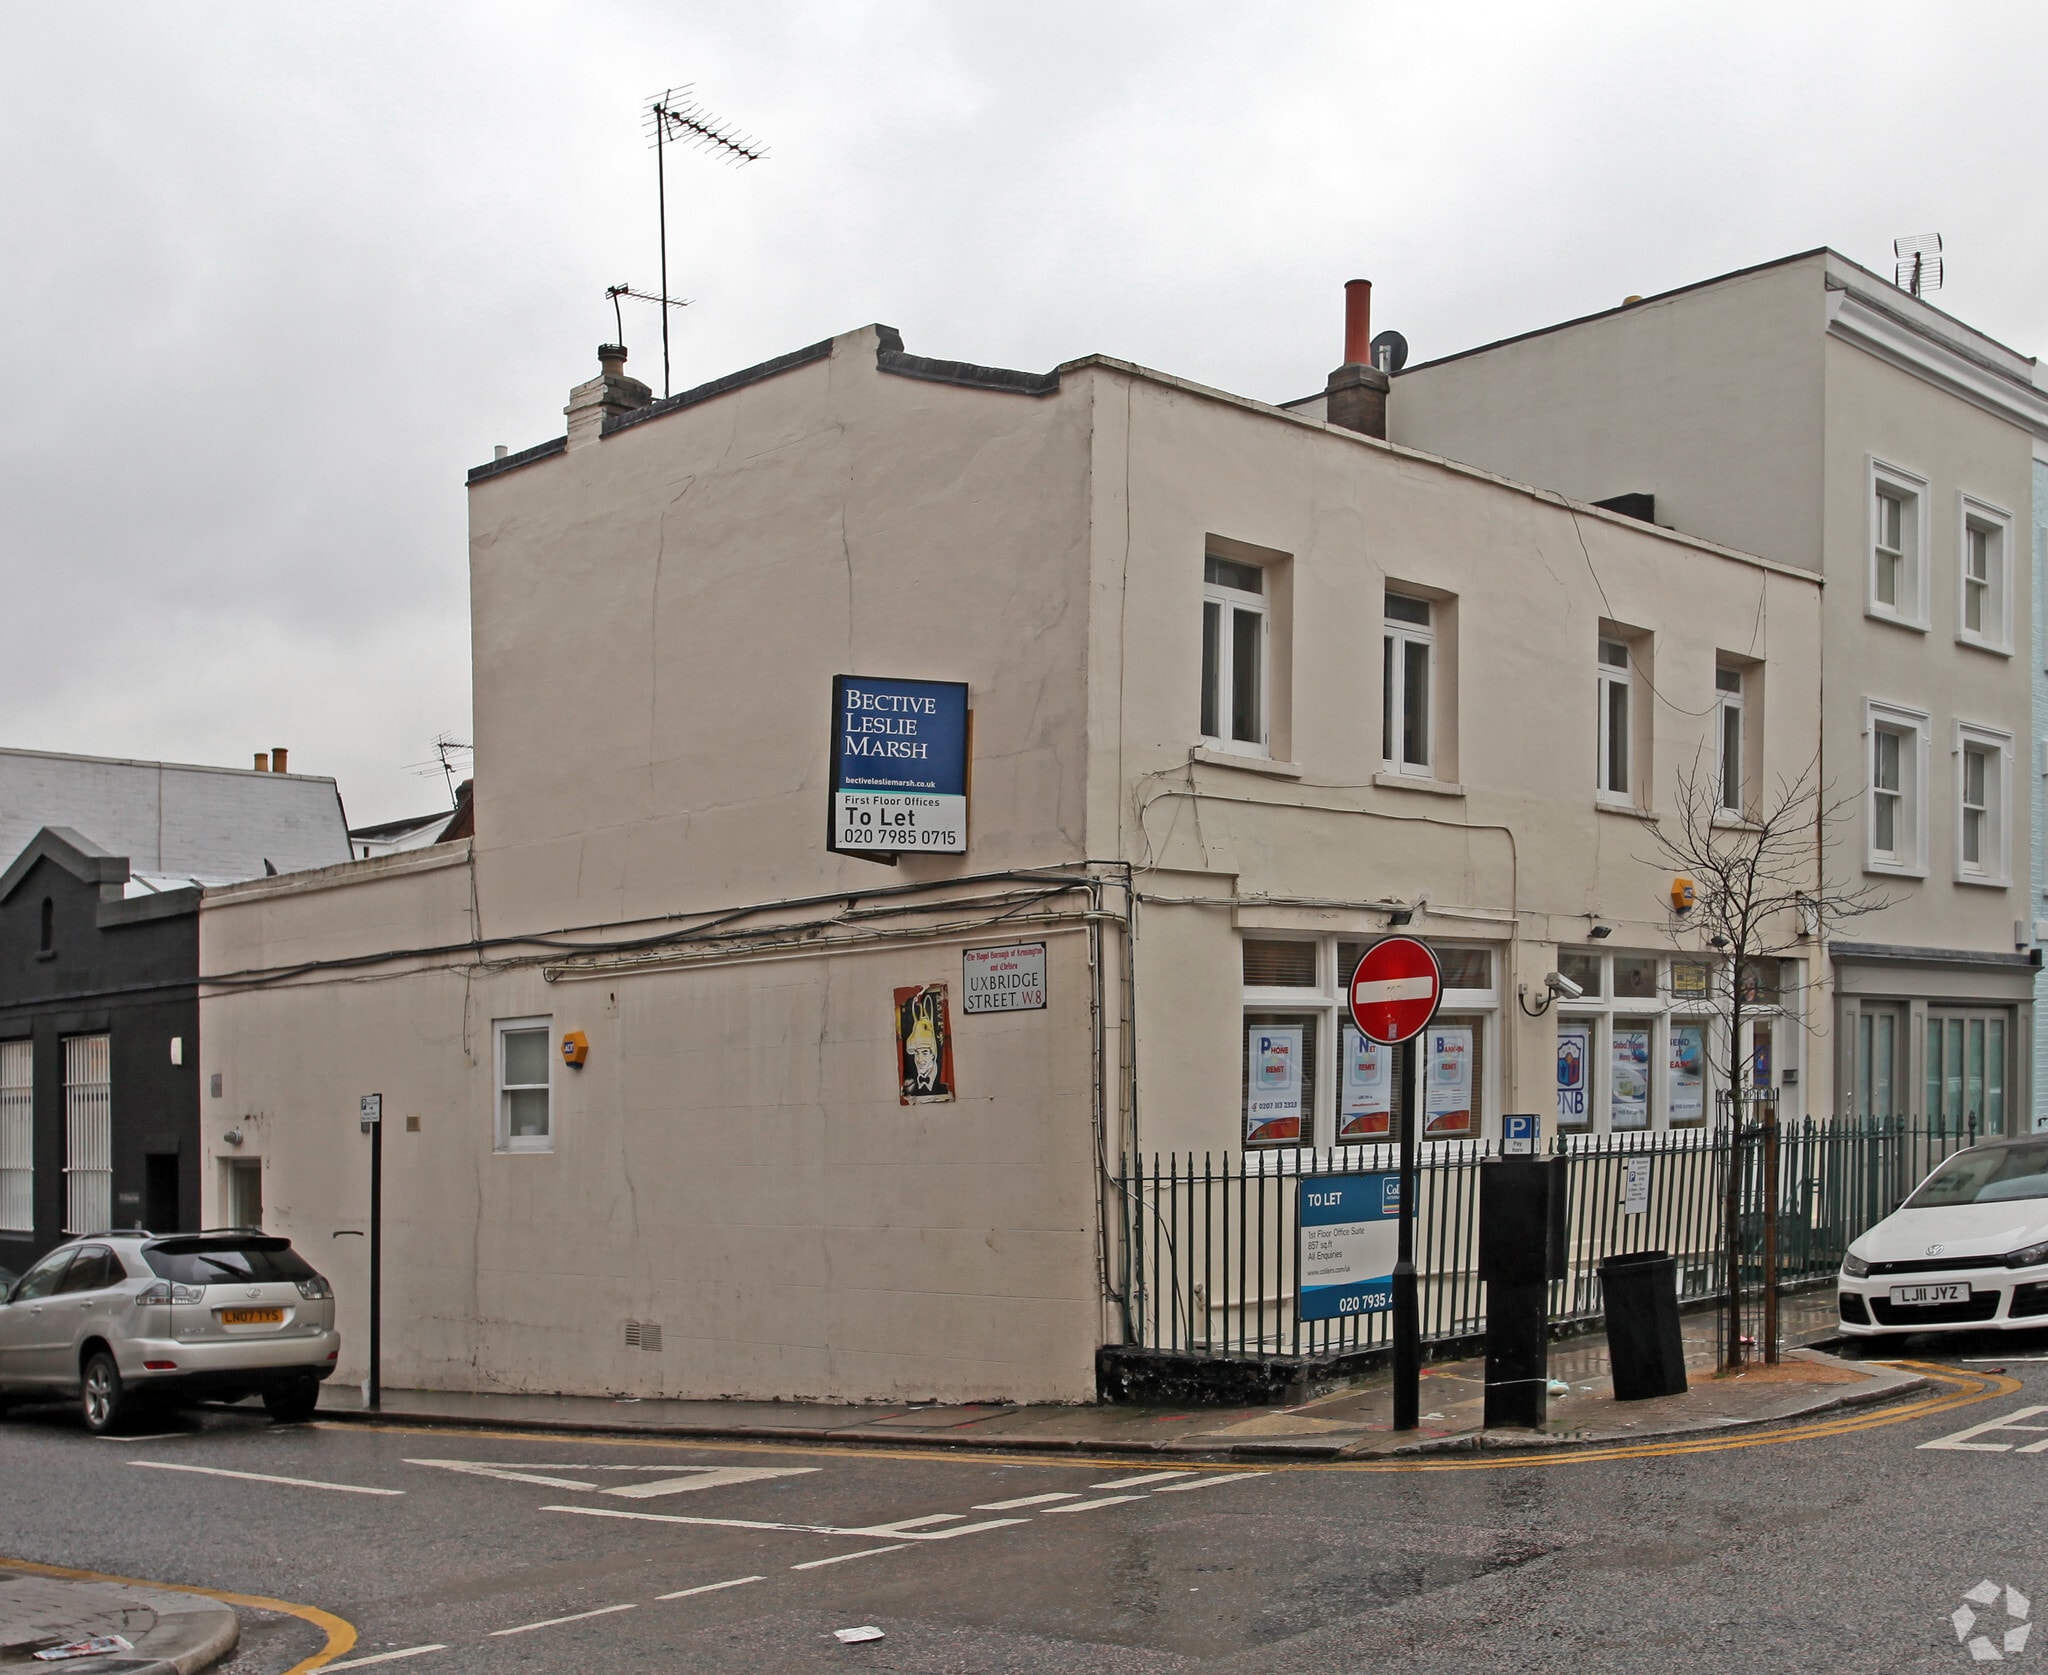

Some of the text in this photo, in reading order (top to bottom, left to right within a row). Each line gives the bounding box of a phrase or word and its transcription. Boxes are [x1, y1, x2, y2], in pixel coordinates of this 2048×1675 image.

[846, 689, 936, 714] BECTIVE
[846, 713, 917, 736] LESLIE
[844, 736, 928, 760] MARSH
[846, 777, 936, 789] bectivelesliemarsh.co.uk
[845, 796, 940, 807] First Floor Offices
[845, 807, 915, 826] To Let
[844, 829, 956, 845] 020 7985 0715
[970, 972, 1038, 991] UXBRIDGE
[1261, 1037, 1288, 1054] PHONE
[1359, 1037, 1376, 1053] NET
[1510, 1118, 1526, 1138] P
[1308, 1192, 1342, 1207] TO LET
[1318, 1230, 1331, 1238] Floor
[1334, 1228, 1349, 1236] Office
[1351, 1226, 1365, 1235] Suite
[1308, 1241, 1319, 1250] 857
[1317, 1250, 1342, 1261] Enquiries
[1902, 1286, 1958, 1302] LJ11 JYZ
[1340, 1297, 1360, 1312] 020
[1362, 1293, 1386, 1309] 7935
[225, 1310, 279, 1323] LN07 TYS
